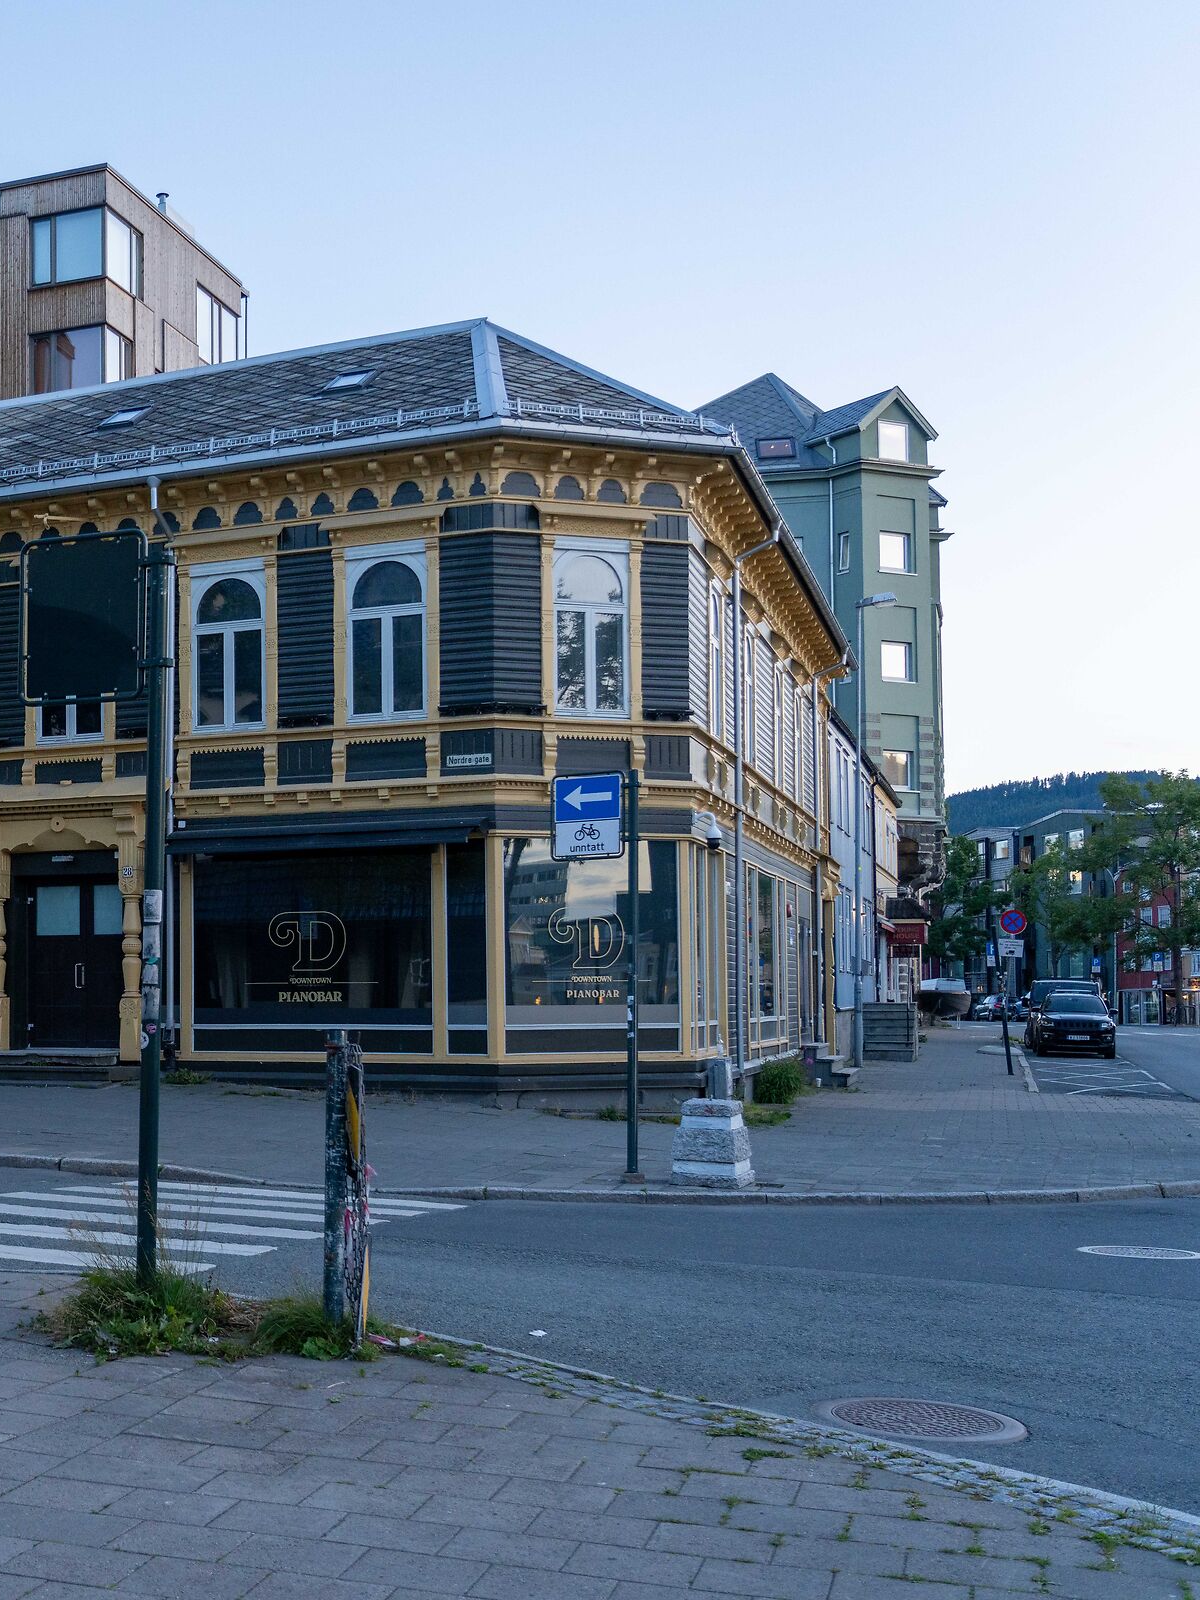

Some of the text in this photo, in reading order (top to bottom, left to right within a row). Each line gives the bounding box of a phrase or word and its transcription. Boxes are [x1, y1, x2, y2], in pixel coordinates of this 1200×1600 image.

[448, 755, 490, 765] Nordre gate
[569, 842, 605, 853] unntatt
[123, 867, 132, 876] 28
[1155, 953, 1160, 961] P
[289, 977, 332, 985] DOWNTOWN
[570, 975, 613, 983] DOWNTOWN
[278, 991, 343, 1003] PIANOBAR
[566, 989, 620, 998] PIANOBAR
